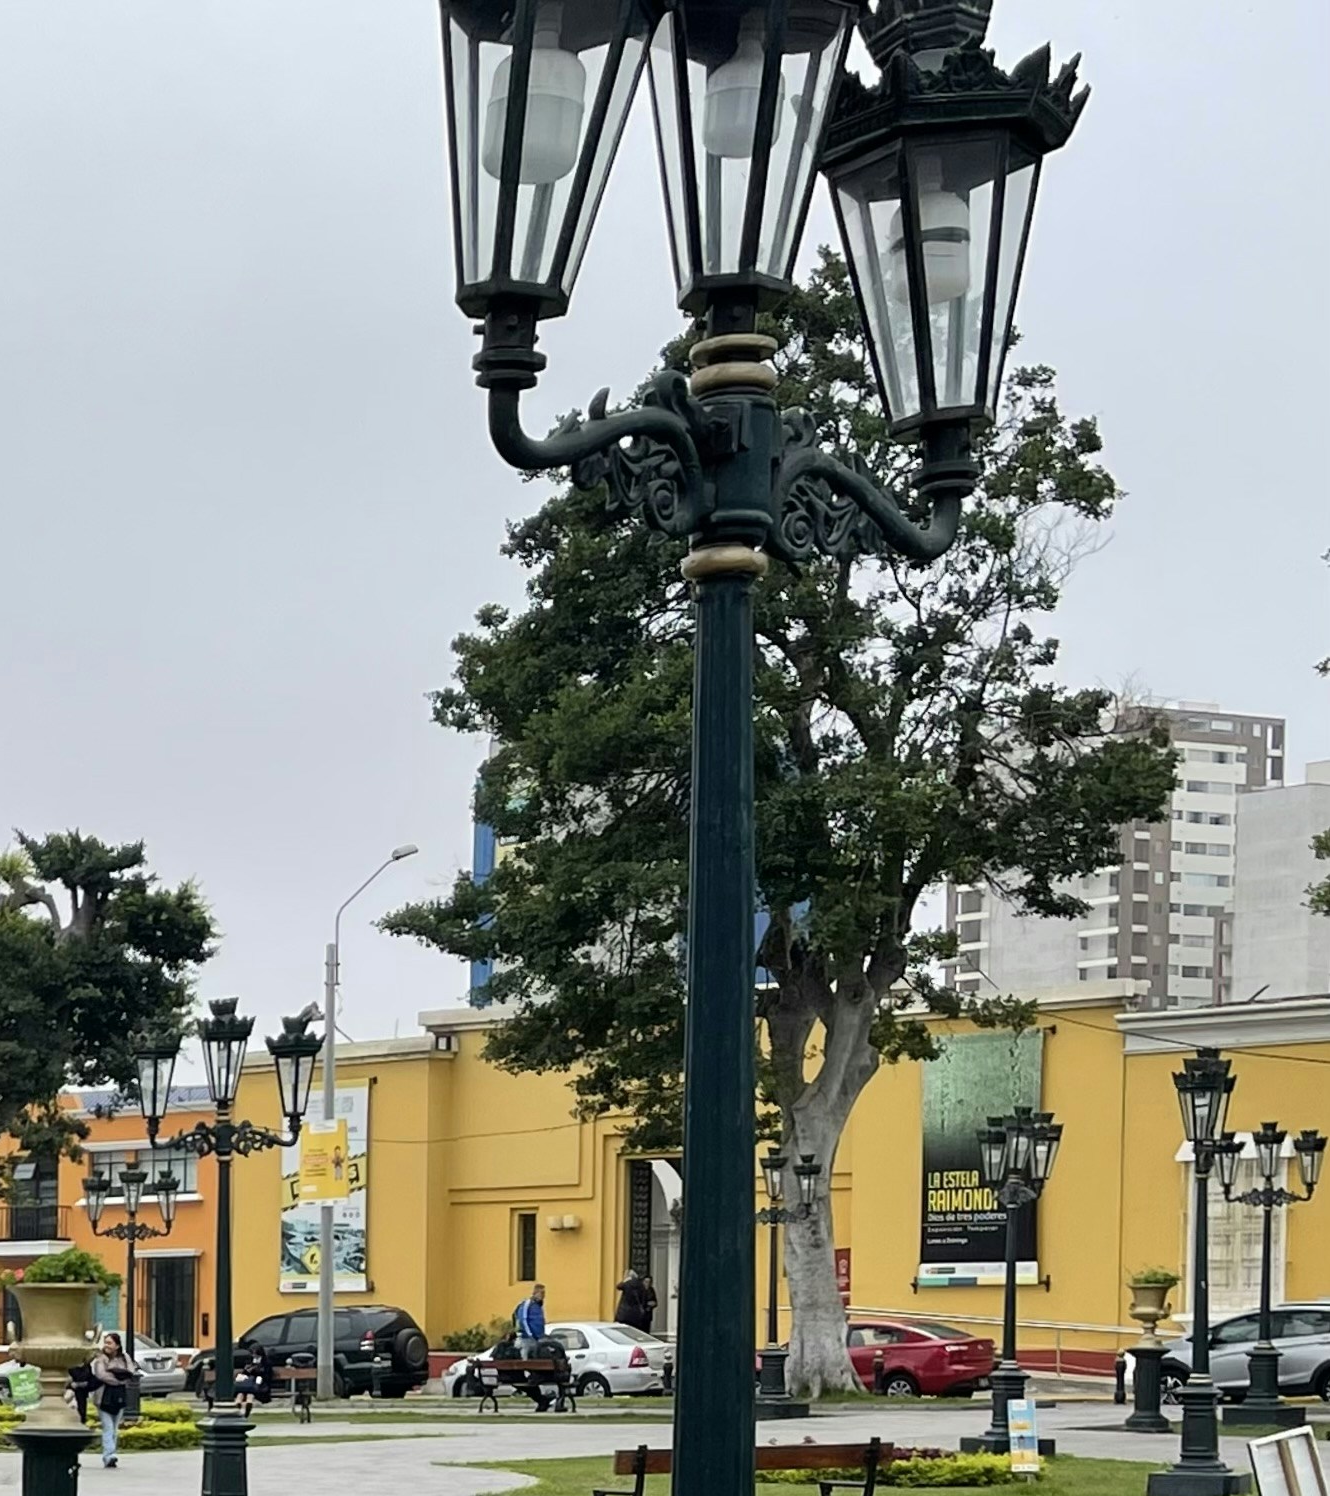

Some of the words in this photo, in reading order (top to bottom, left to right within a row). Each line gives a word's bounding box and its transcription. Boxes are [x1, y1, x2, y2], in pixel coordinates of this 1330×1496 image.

[927, 1172, 941, 1188] LA
[943, 1170, 979, 1188] ESTELA
[945, 1213, 955, 1221] de
[957, 1212, 972, 1221] tres
[973, 1212, 1007, 1224] poderes
